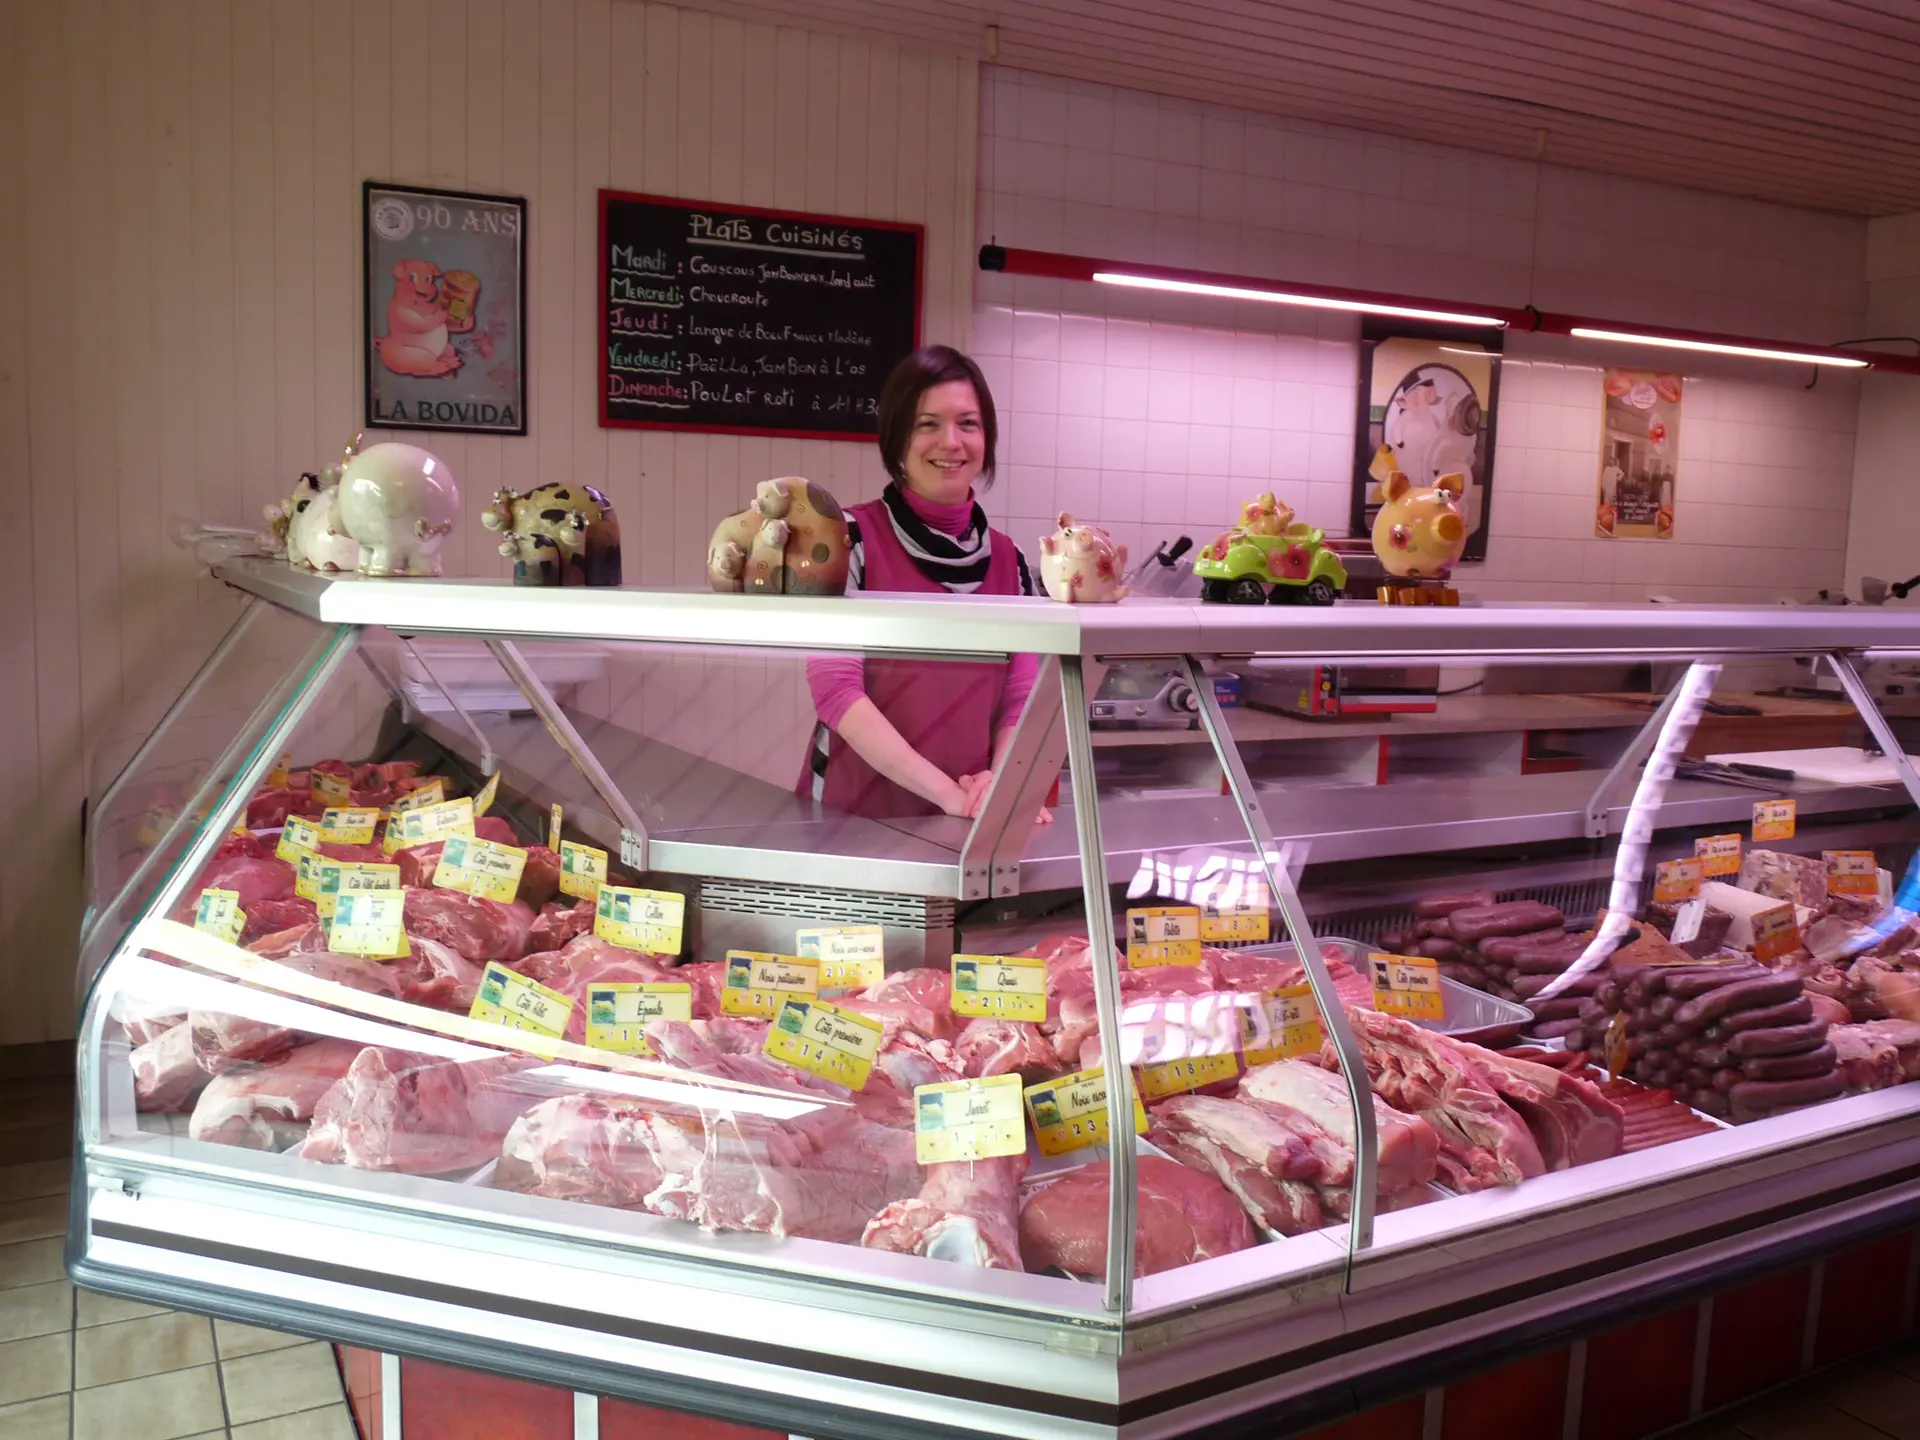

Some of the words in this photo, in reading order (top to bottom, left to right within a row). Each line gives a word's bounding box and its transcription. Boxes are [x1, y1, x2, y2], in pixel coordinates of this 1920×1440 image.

[417, 205, 451, 230] 90
[461, 208, 517, 236] ANS
[690, 255, 755, 276] Couscous
[689, 286, 769, 307] Choucroute
[609, 307, 669, 331] Jeudi
[375, 399, 408, 420] LA
[418, 401, 516, 425] BOVIDA
[1071, 1090, 1091, 1109] Noix
